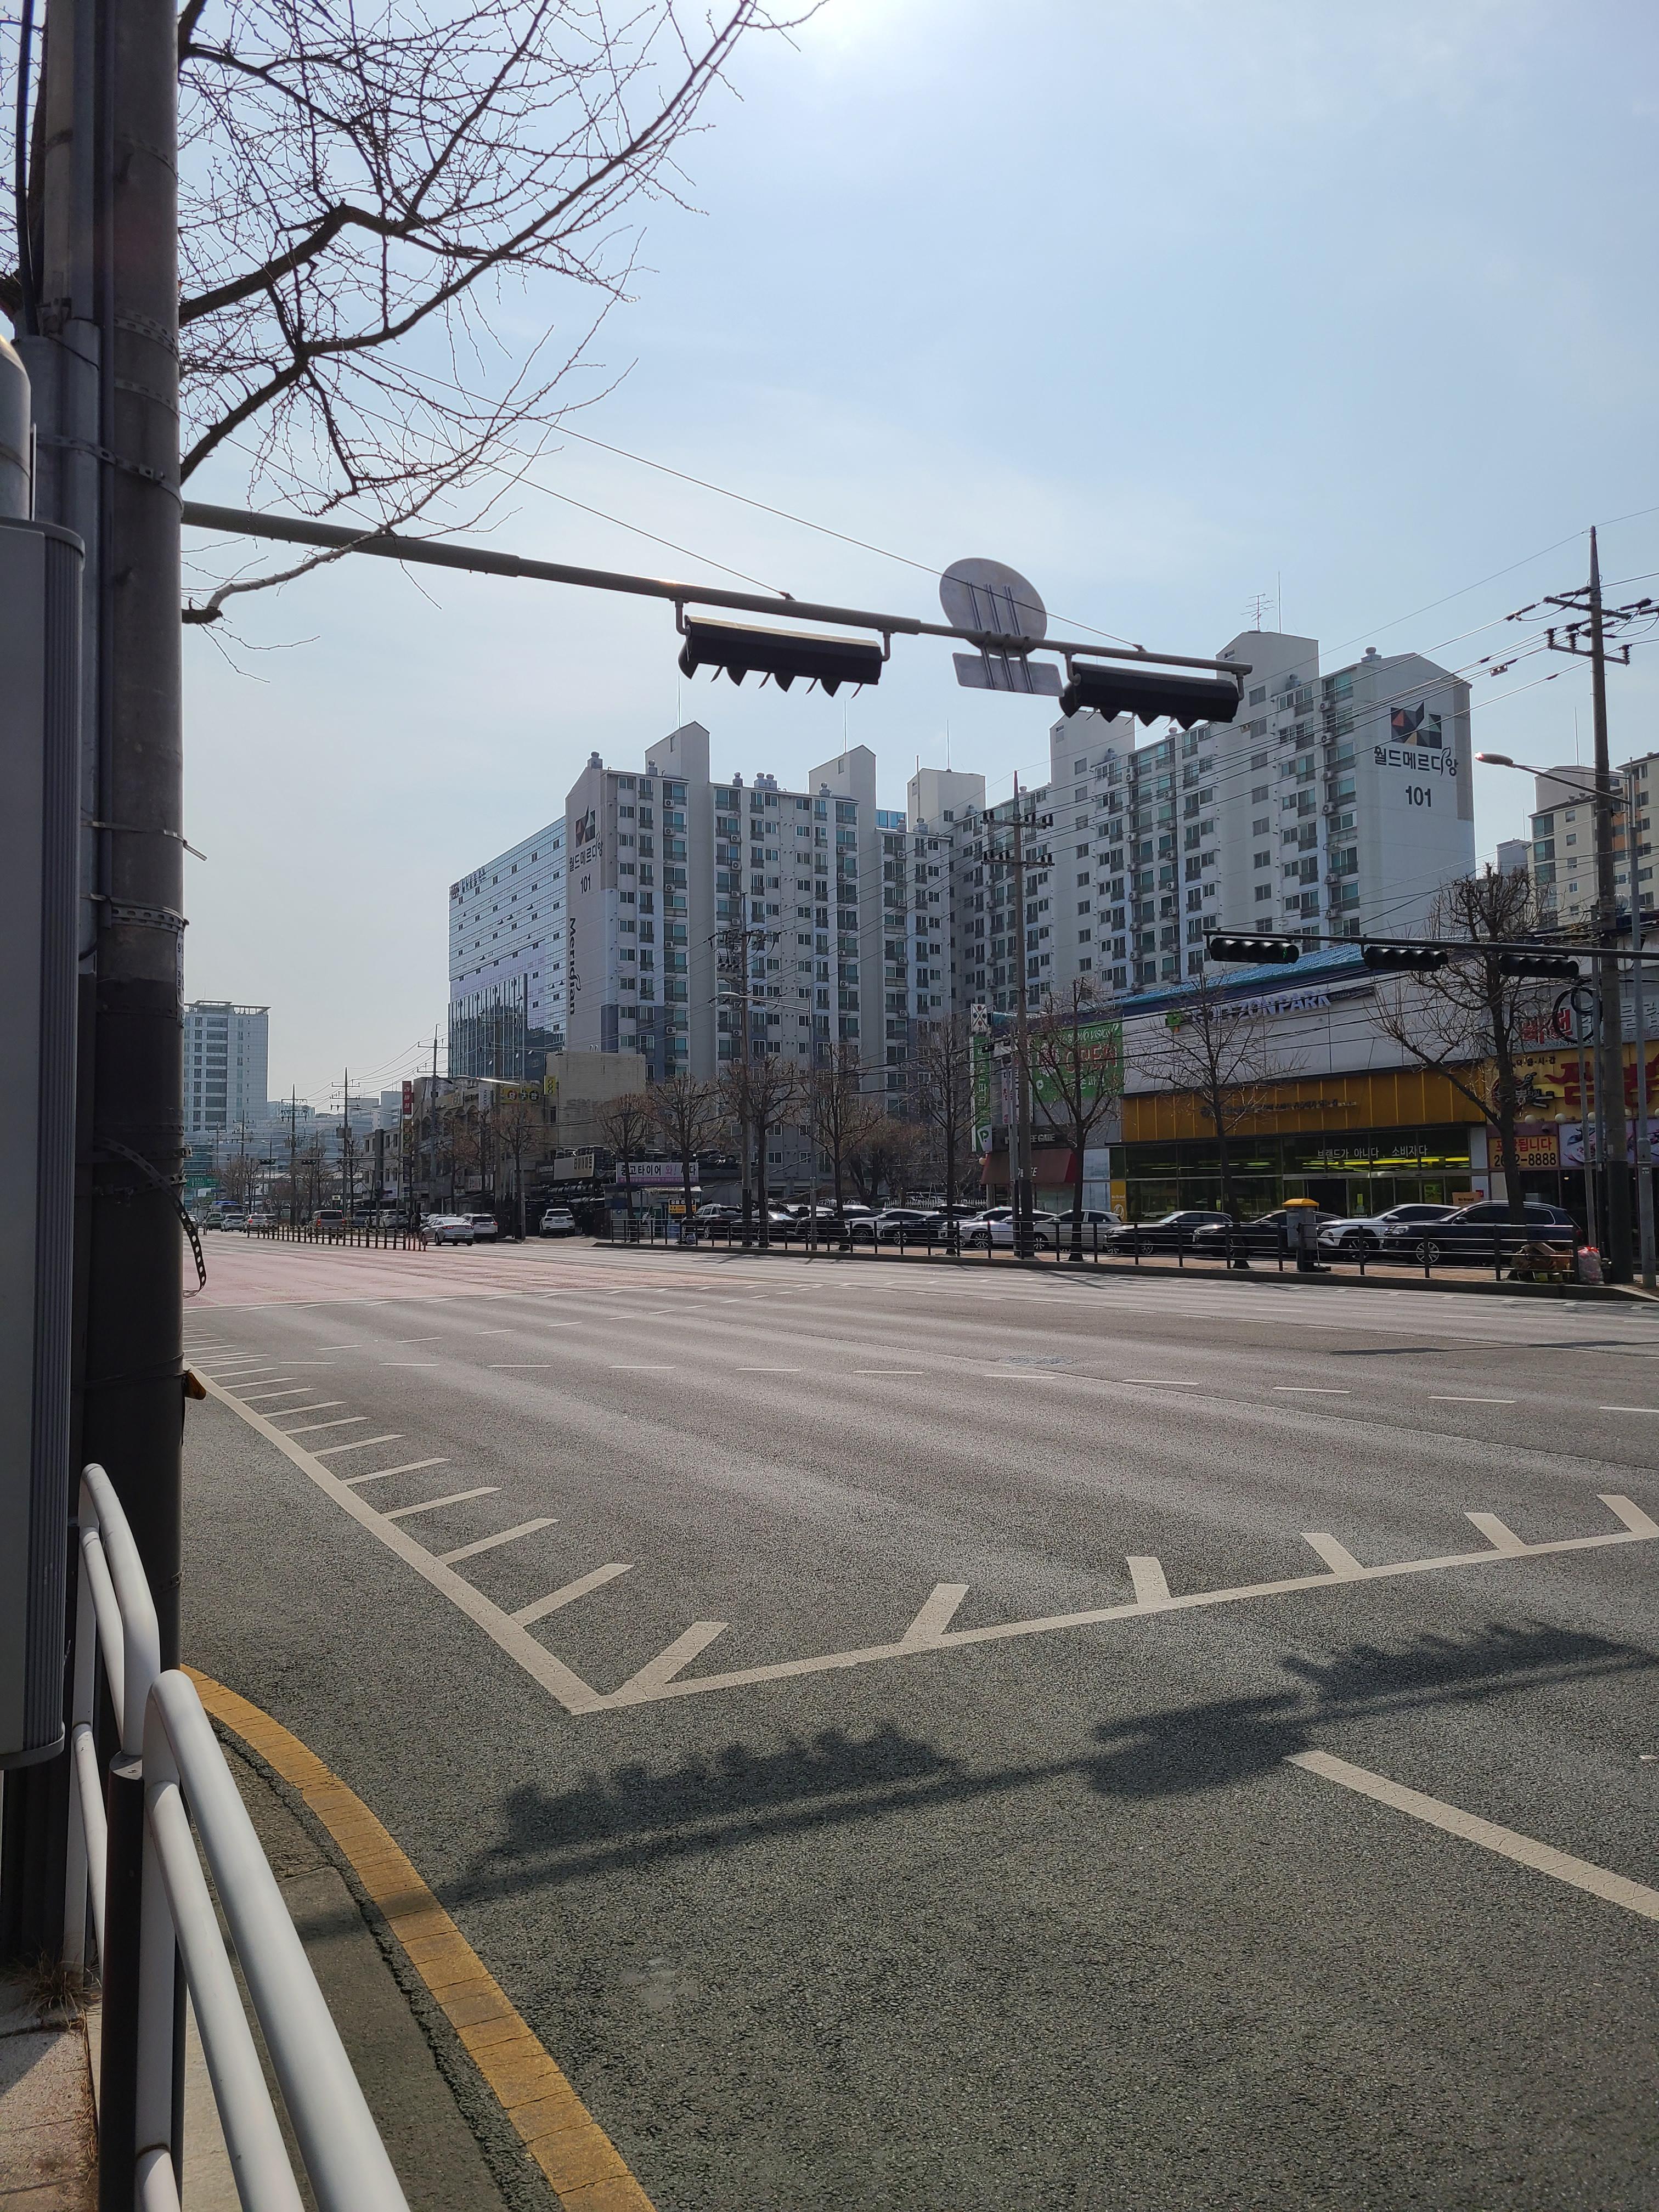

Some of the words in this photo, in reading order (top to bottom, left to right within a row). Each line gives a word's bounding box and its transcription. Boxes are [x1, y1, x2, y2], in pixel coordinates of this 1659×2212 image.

[1374, 746, 1459, 777] 월드메르디앙
[1405, 786, 1431, 808] 101
[569, 831, 603, 872] 월드메르디앙
[580, 873, 591, 894] 101
[569, 918, 581, 1014] Meridian
[1317, 1148, 1350, 1160] 브랜드가
[1391, 1144, 1428, 1157] 소비자다
[1496, 1137, 1552, 1152] 포됩니다
[620, 1164, 661, 1176] 중고타이어
